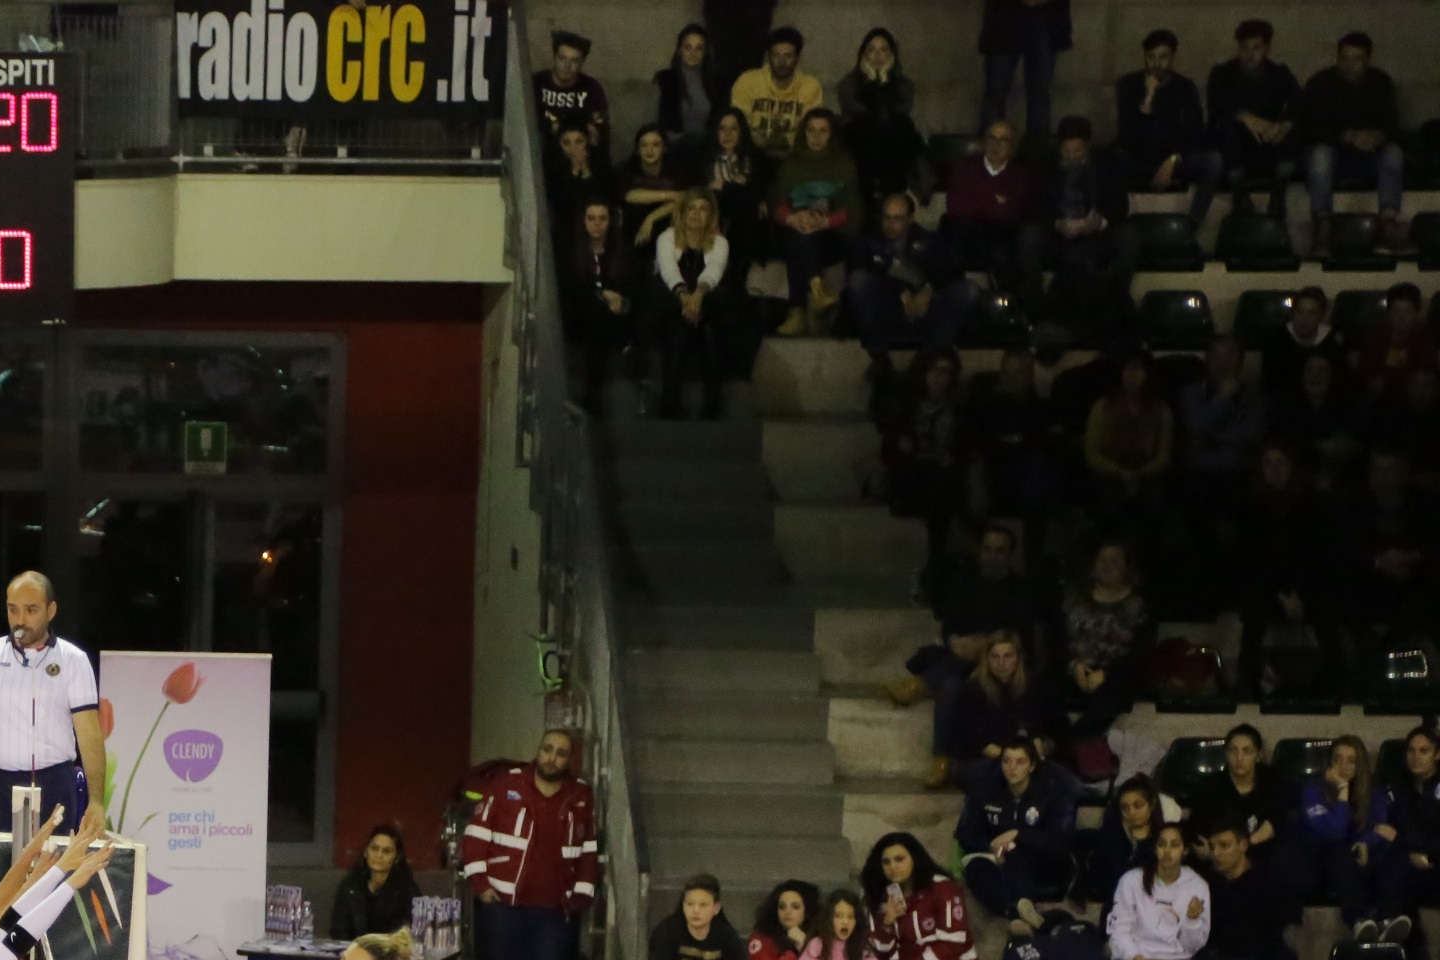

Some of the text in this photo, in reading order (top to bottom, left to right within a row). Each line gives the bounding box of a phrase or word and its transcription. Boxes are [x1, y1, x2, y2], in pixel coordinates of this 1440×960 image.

[171, 742, 216, 760] CLENDY
[168, 810, 215, 824] per chi
[169, 824, 200, 835] ama
[208, 823, 253, 837] piccoli
[168, 836, 202, 851] gesti
